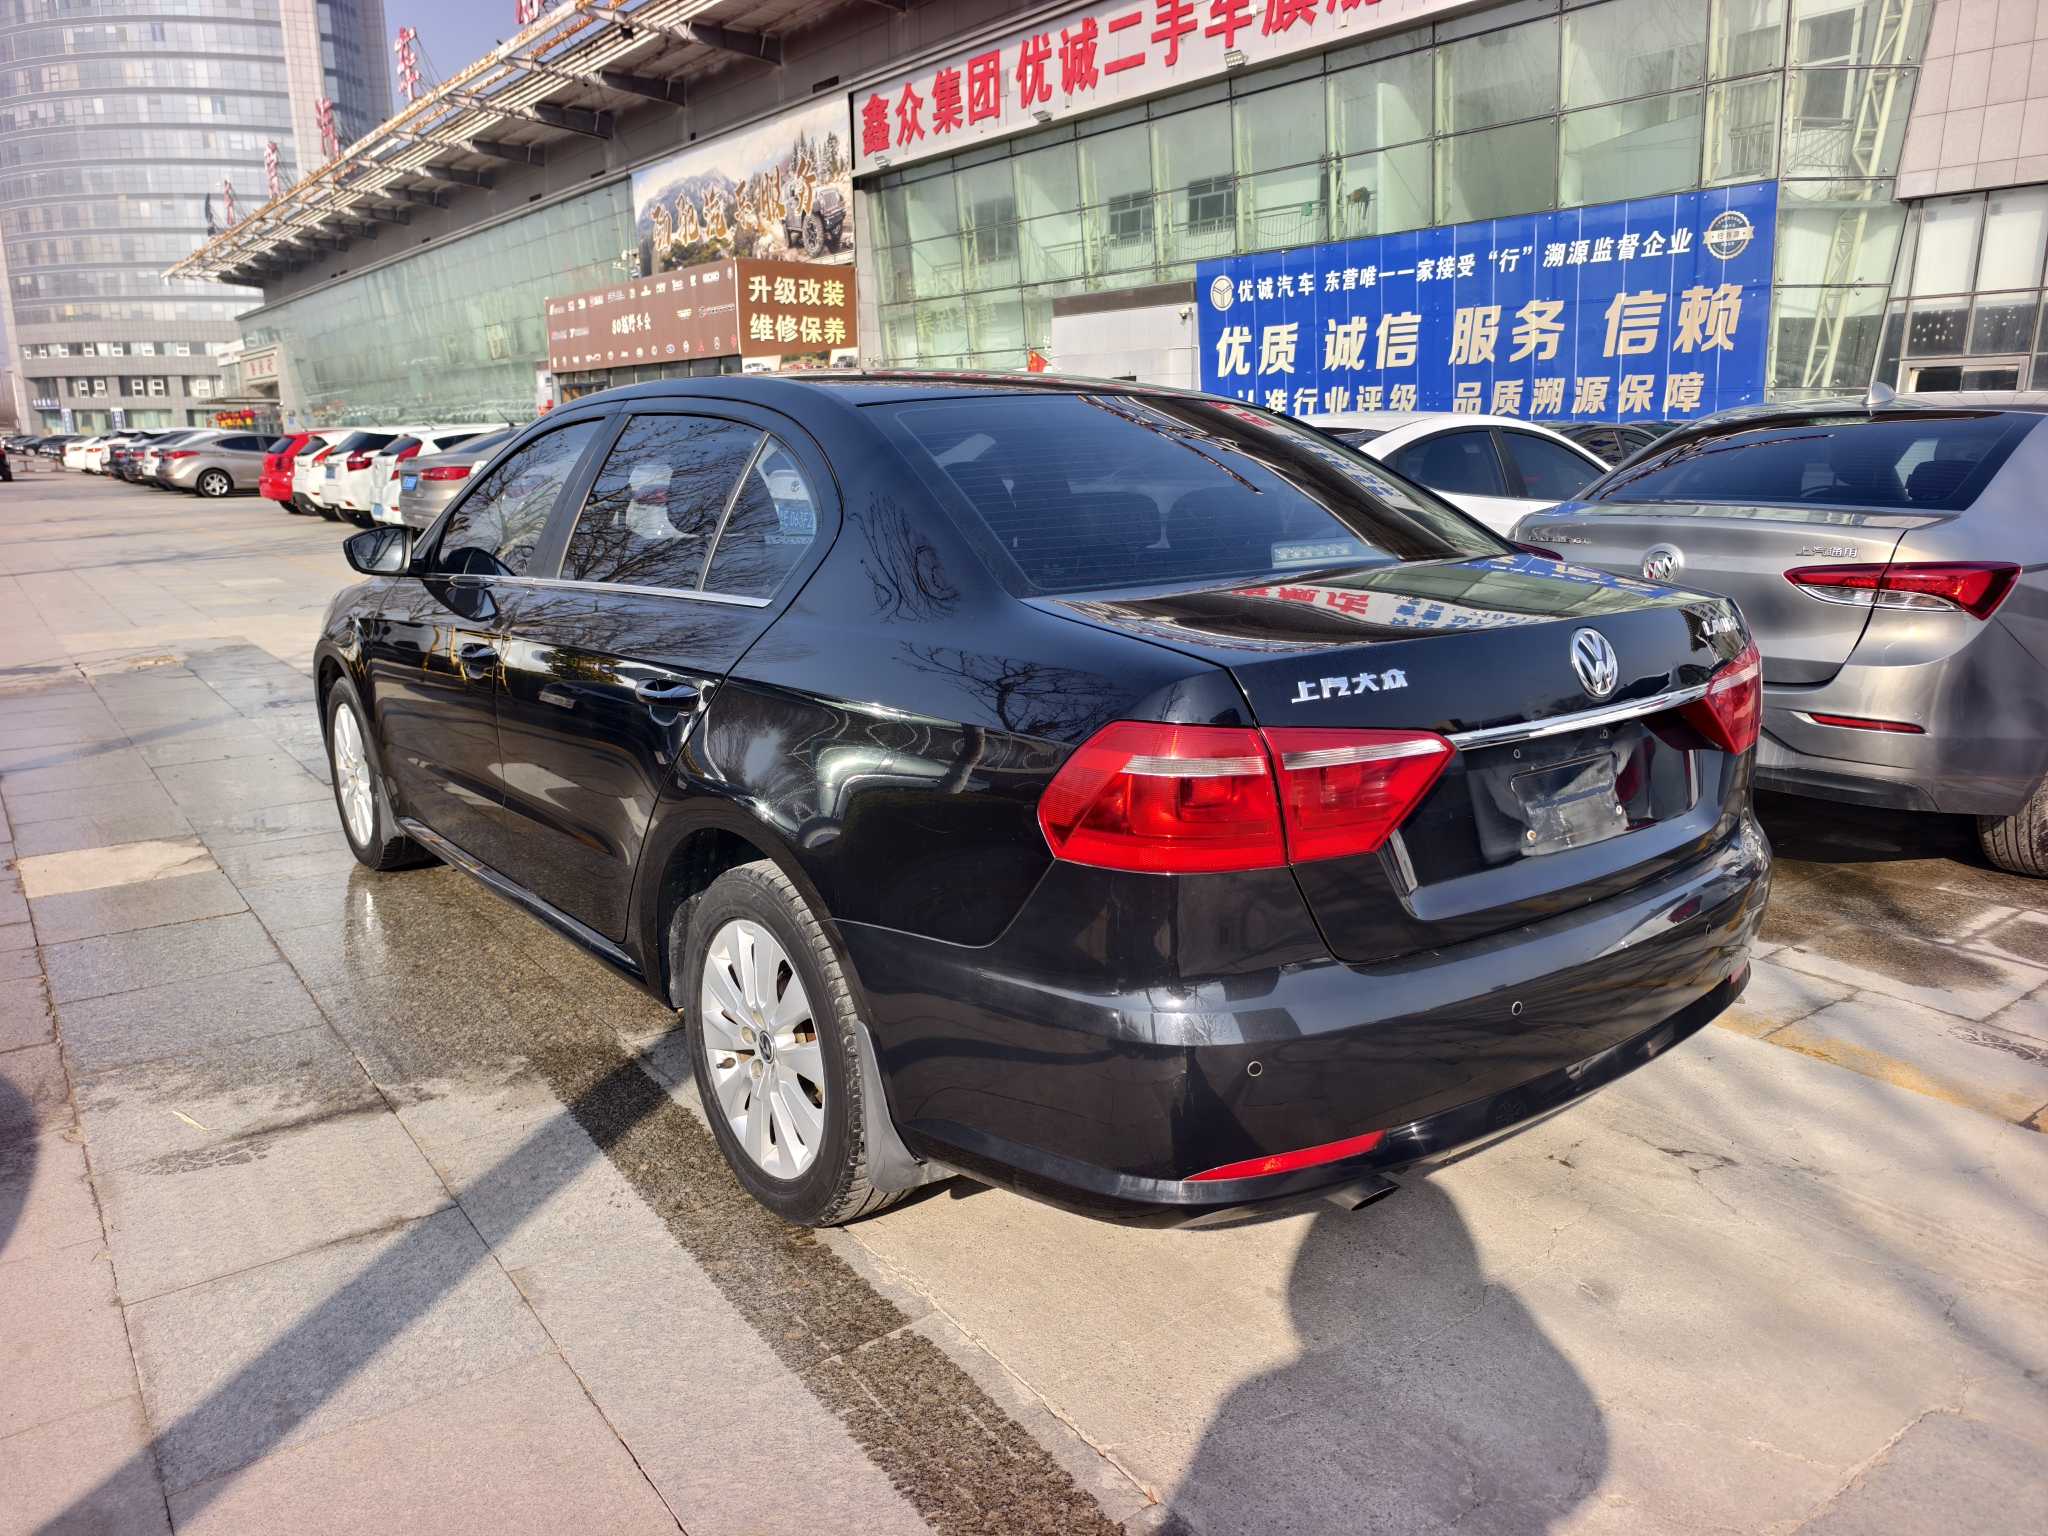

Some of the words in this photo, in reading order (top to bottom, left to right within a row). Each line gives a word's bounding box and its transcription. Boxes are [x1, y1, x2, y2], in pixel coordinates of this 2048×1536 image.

[862, 48, 1001, 157] 鑫众集团
[748, 275, 846, 307] 升级改装
[1237, 272, 1315, 303] 优诚汽车
[749, 313, 847, 344] 维修保养
[1216, 321, 1298, 378] 优质
[1323, 311, 1422, 372] 诚信
[1448, 299, 1565, 366] 服务
[1602, 282, 1744, 358] 信赖
[1452, 371, 1705, 416] 品质溯源保障
